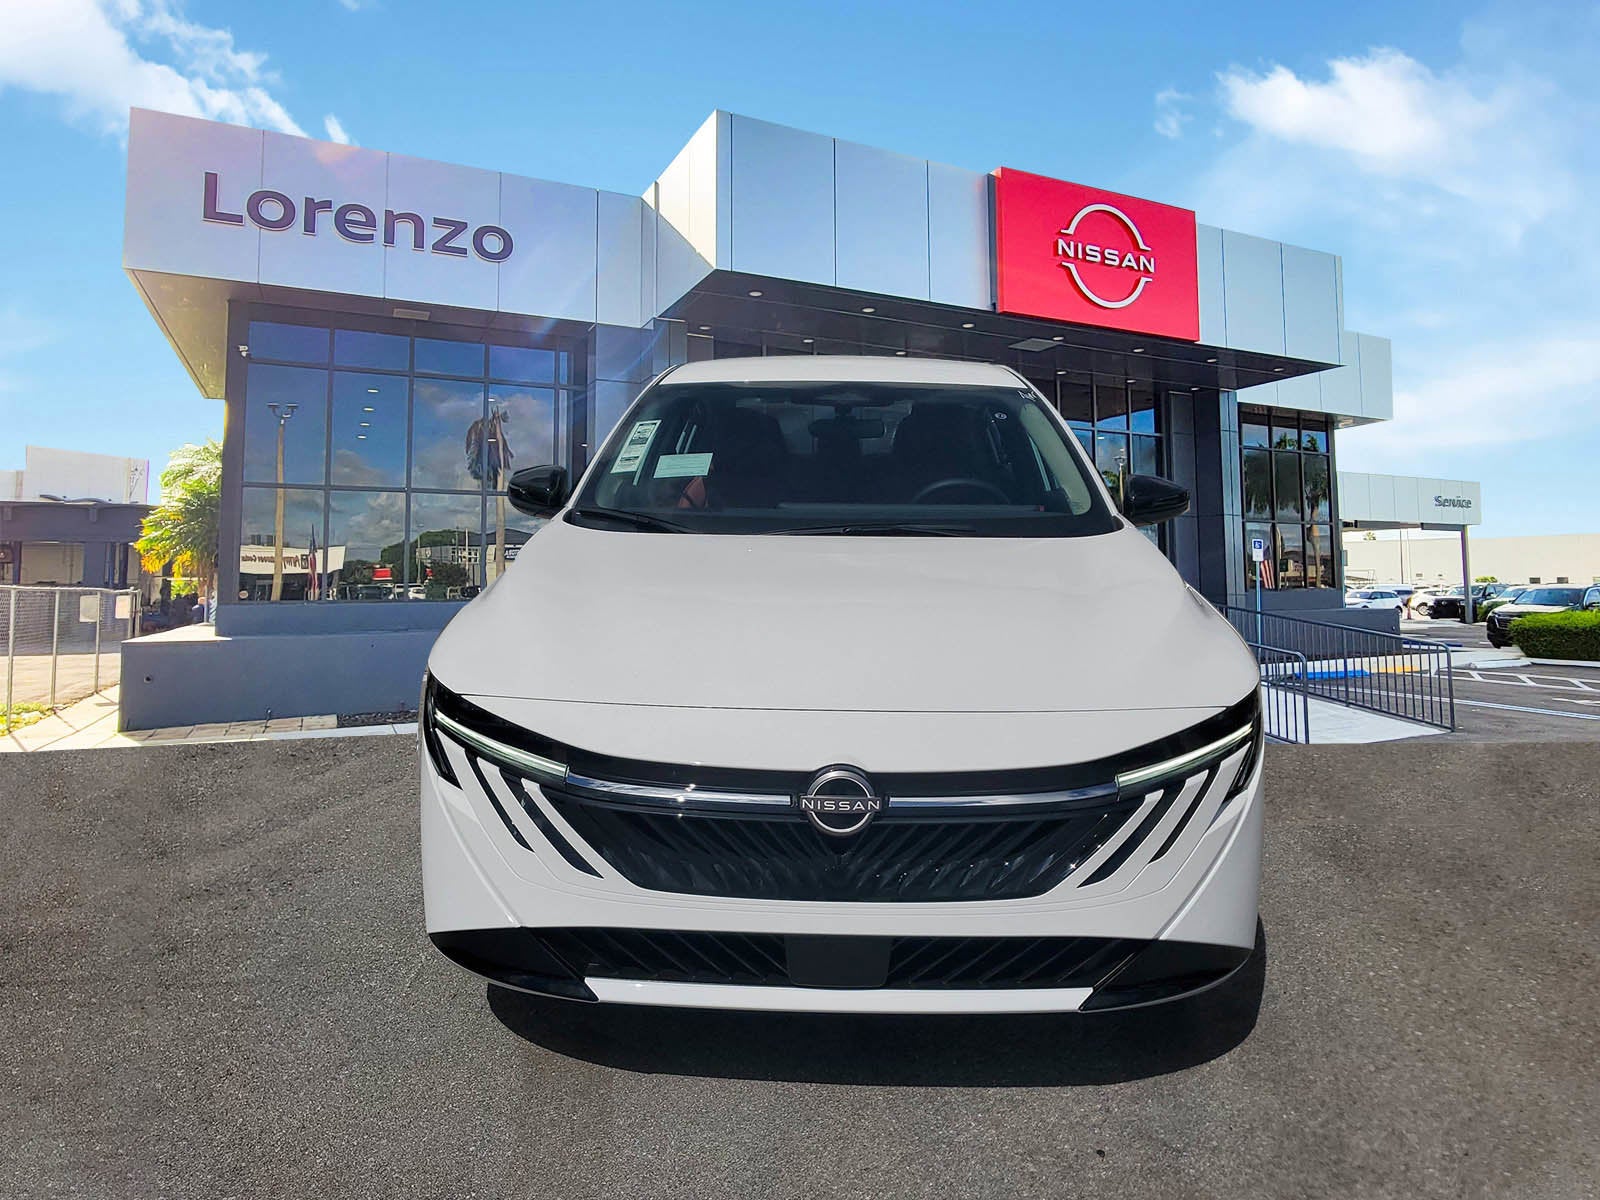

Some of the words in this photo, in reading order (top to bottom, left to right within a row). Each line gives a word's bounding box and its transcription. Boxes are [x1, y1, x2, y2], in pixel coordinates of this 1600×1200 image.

[203, 171, 514, 262] Lorenzo
[1057, 238, 1156, 273] NISSAN
[1434, 495, 1472, 509] Service
[802, 799, 880, 811] NISSAN
